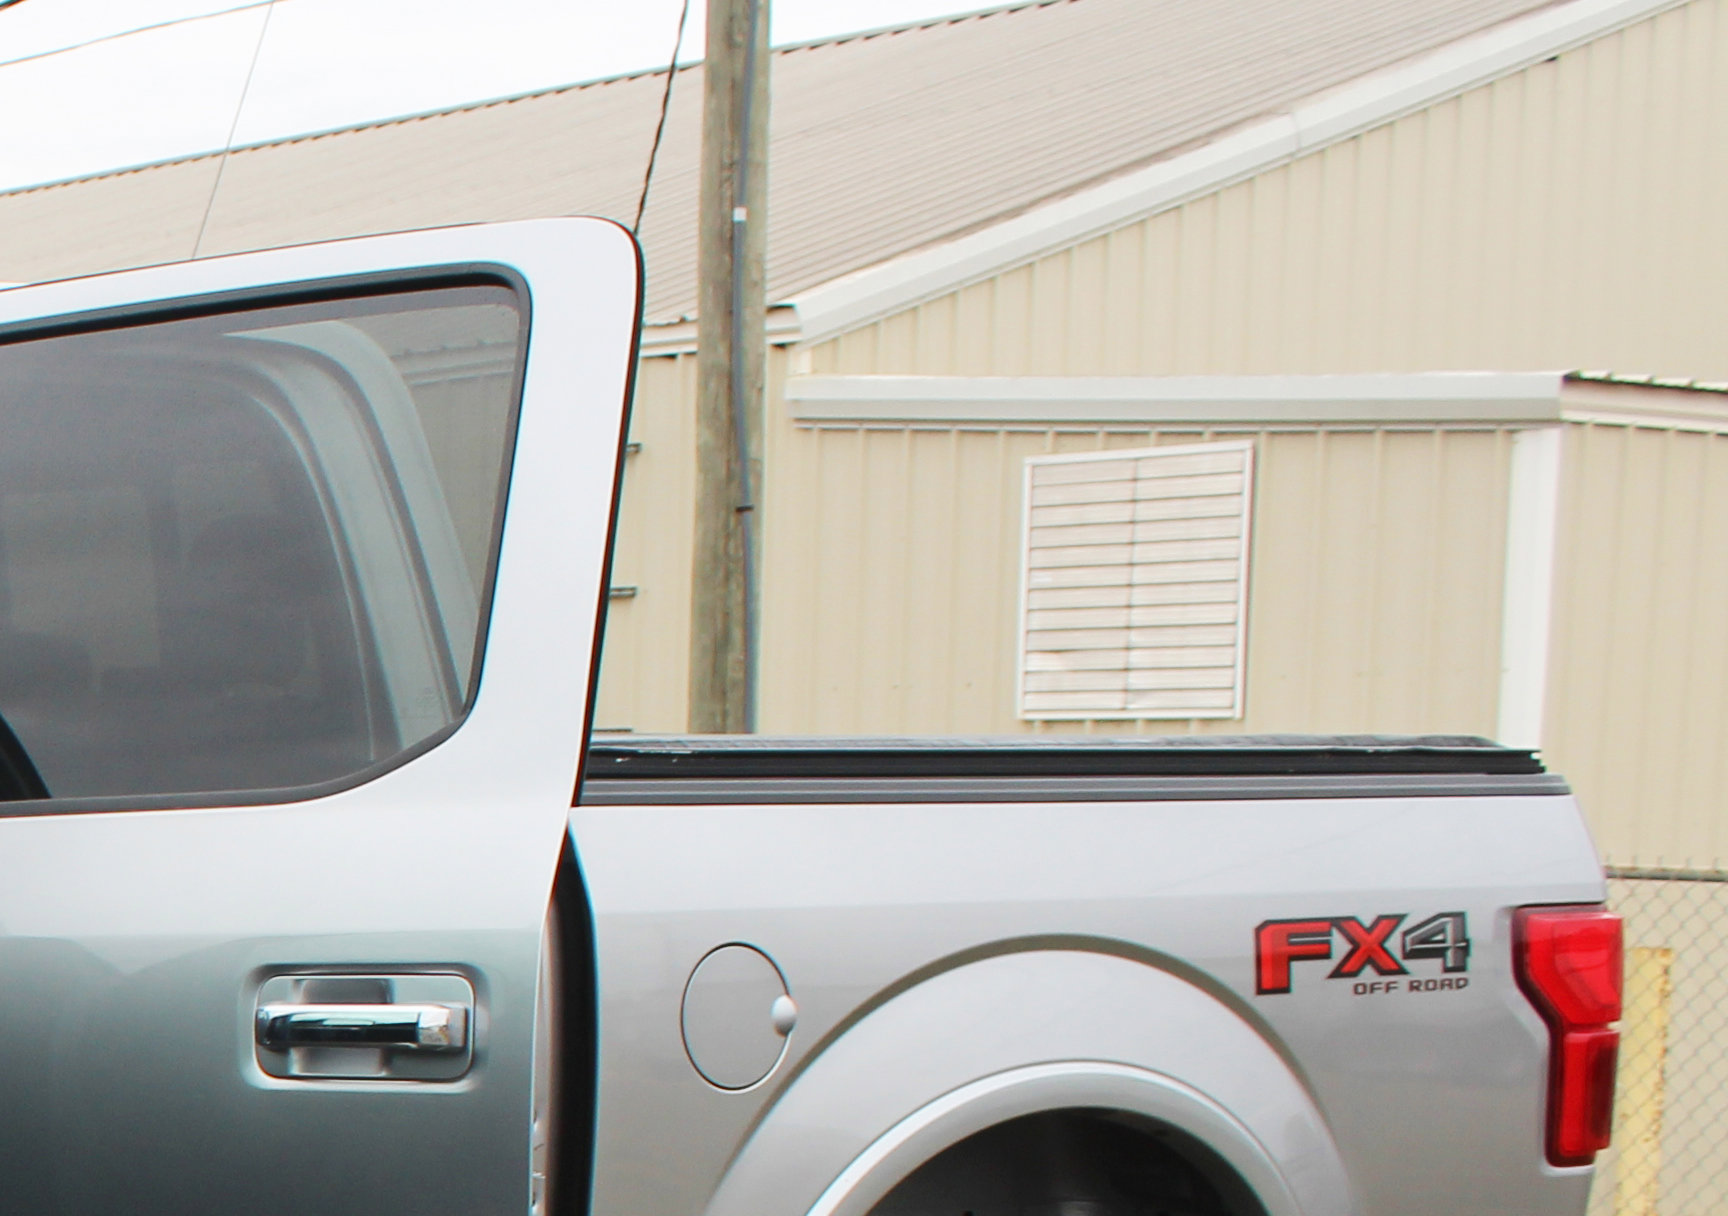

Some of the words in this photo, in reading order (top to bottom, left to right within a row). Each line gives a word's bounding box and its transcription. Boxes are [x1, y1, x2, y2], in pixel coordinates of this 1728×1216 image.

[1255, 911, 1471, 995] FX4
[1353, 982, 1399, 995] OFF
[1408, 977, 1469, 992] ROAD
